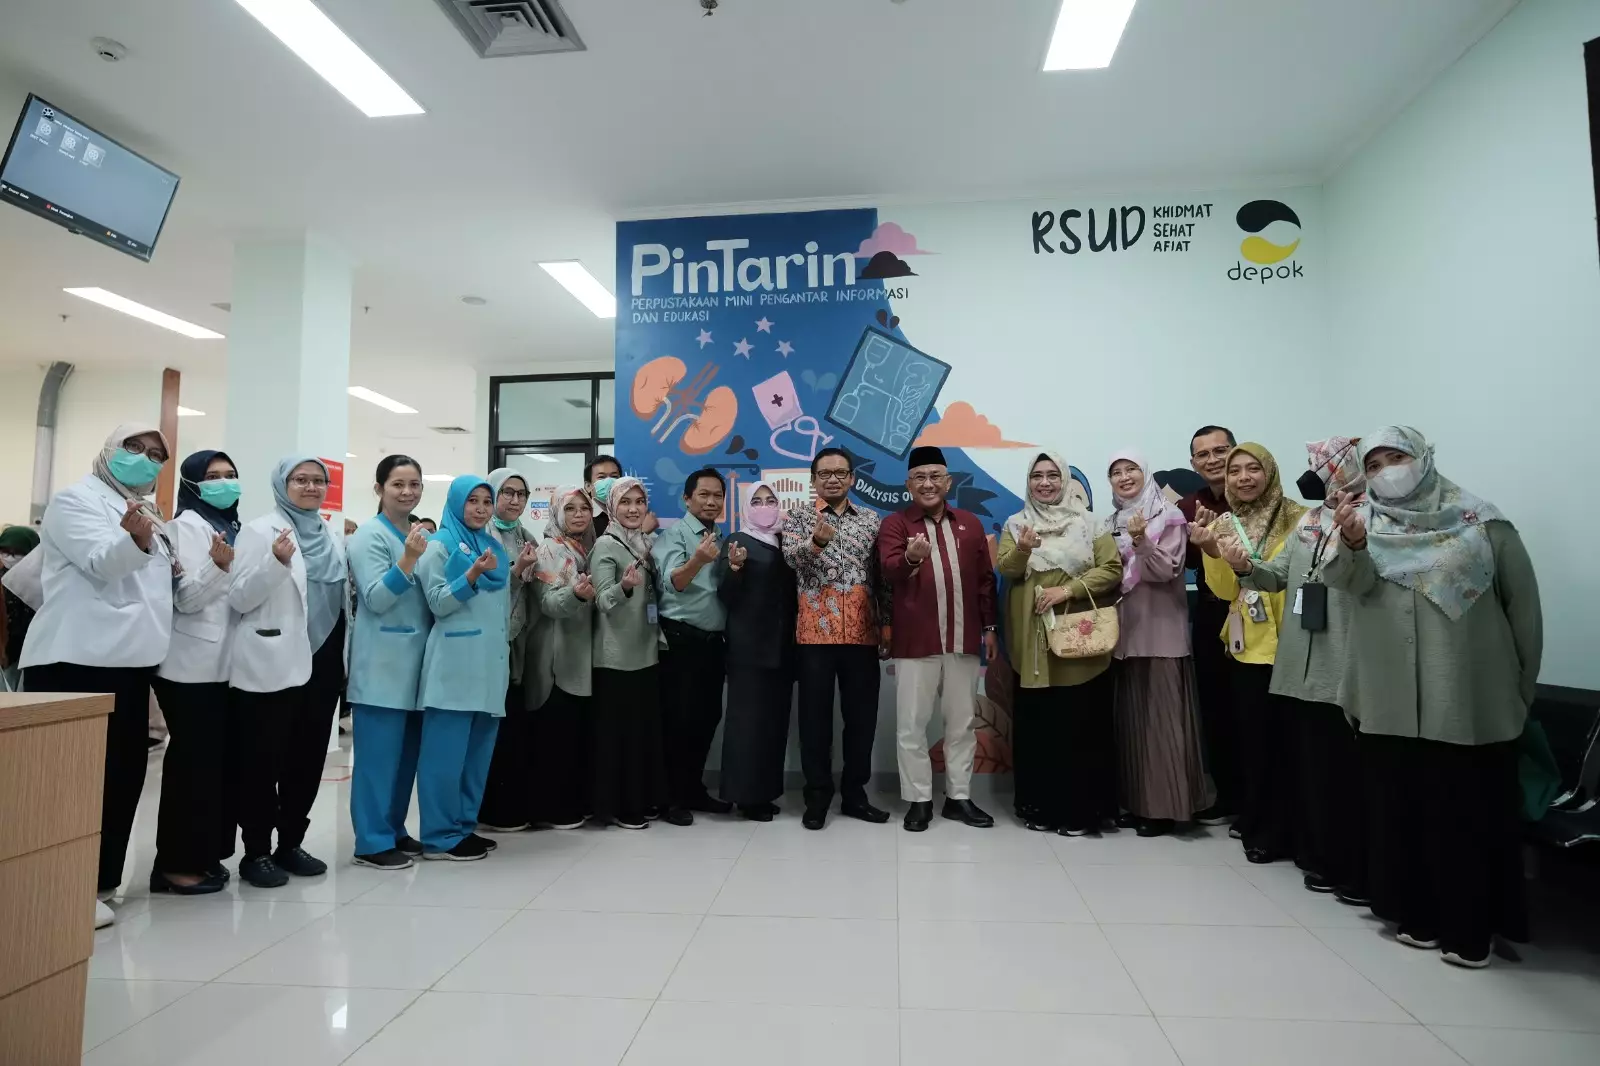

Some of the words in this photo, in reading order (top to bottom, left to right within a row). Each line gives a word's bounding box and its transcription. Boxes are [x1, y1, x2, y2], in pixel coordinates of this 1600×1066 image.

[1153, 203, 1213, 218] KHIDMAT
[1031, 205, 1146, 254] RSUD
[1153, 223, 1195, 237] SEHAT
[1153, 240, 1191, 252] AFIAT
[631, 239, 856, 296] PinTarin
[1227, 260, 1304, 284] depok
[631, 296, 719, 310] PERPUSTAKAAN
[725, 295, 753, 307] MINI
[760, 291, 828, 306] PENGANTAR
[836, 287, 909, 302] INFORMASI
[632, 311, 658, 324] DAN
[663, 310, 709, 322] EDUKASI
[855, 478, 899, 503] DIALYSIS
